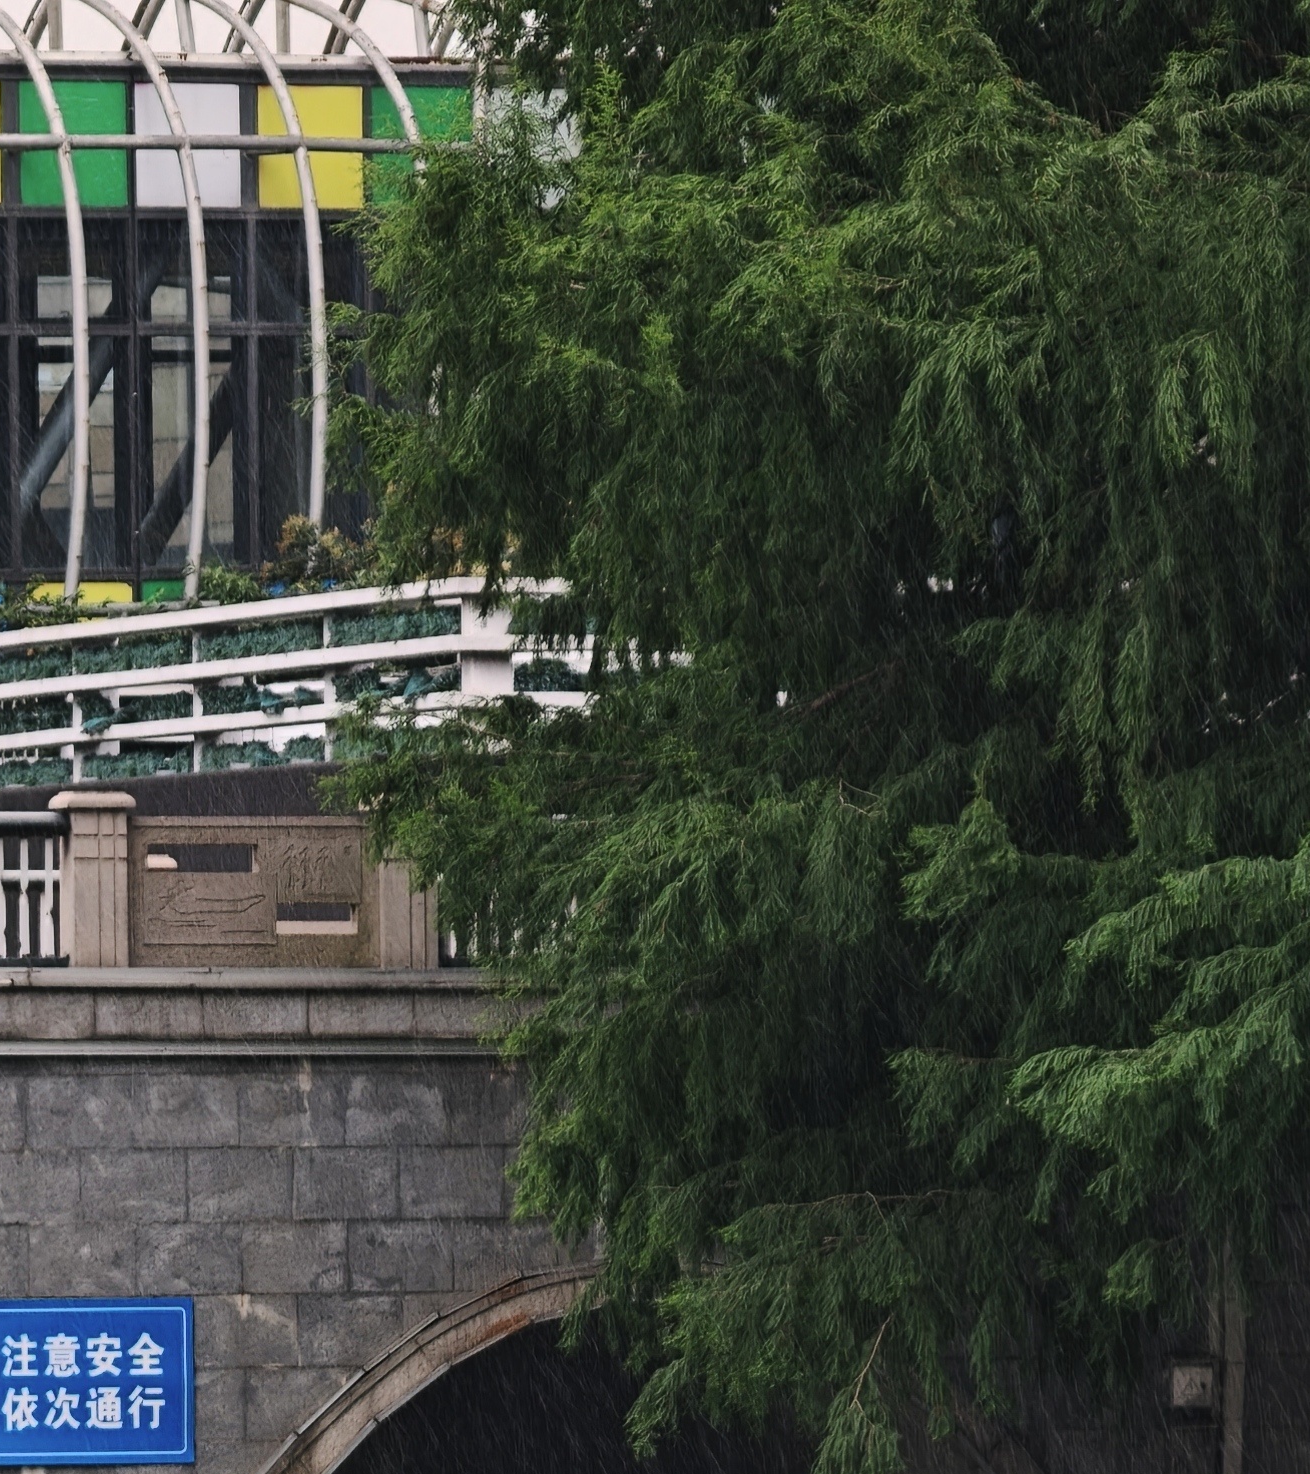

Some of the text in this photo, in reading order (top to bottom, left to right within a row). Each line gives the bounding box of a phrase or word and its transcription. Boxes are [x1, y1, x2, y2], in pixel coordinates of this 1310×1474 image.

[1, 1332, 165, 1377] 注意安全
[1, 1386, 166, 1431] 依次通行
